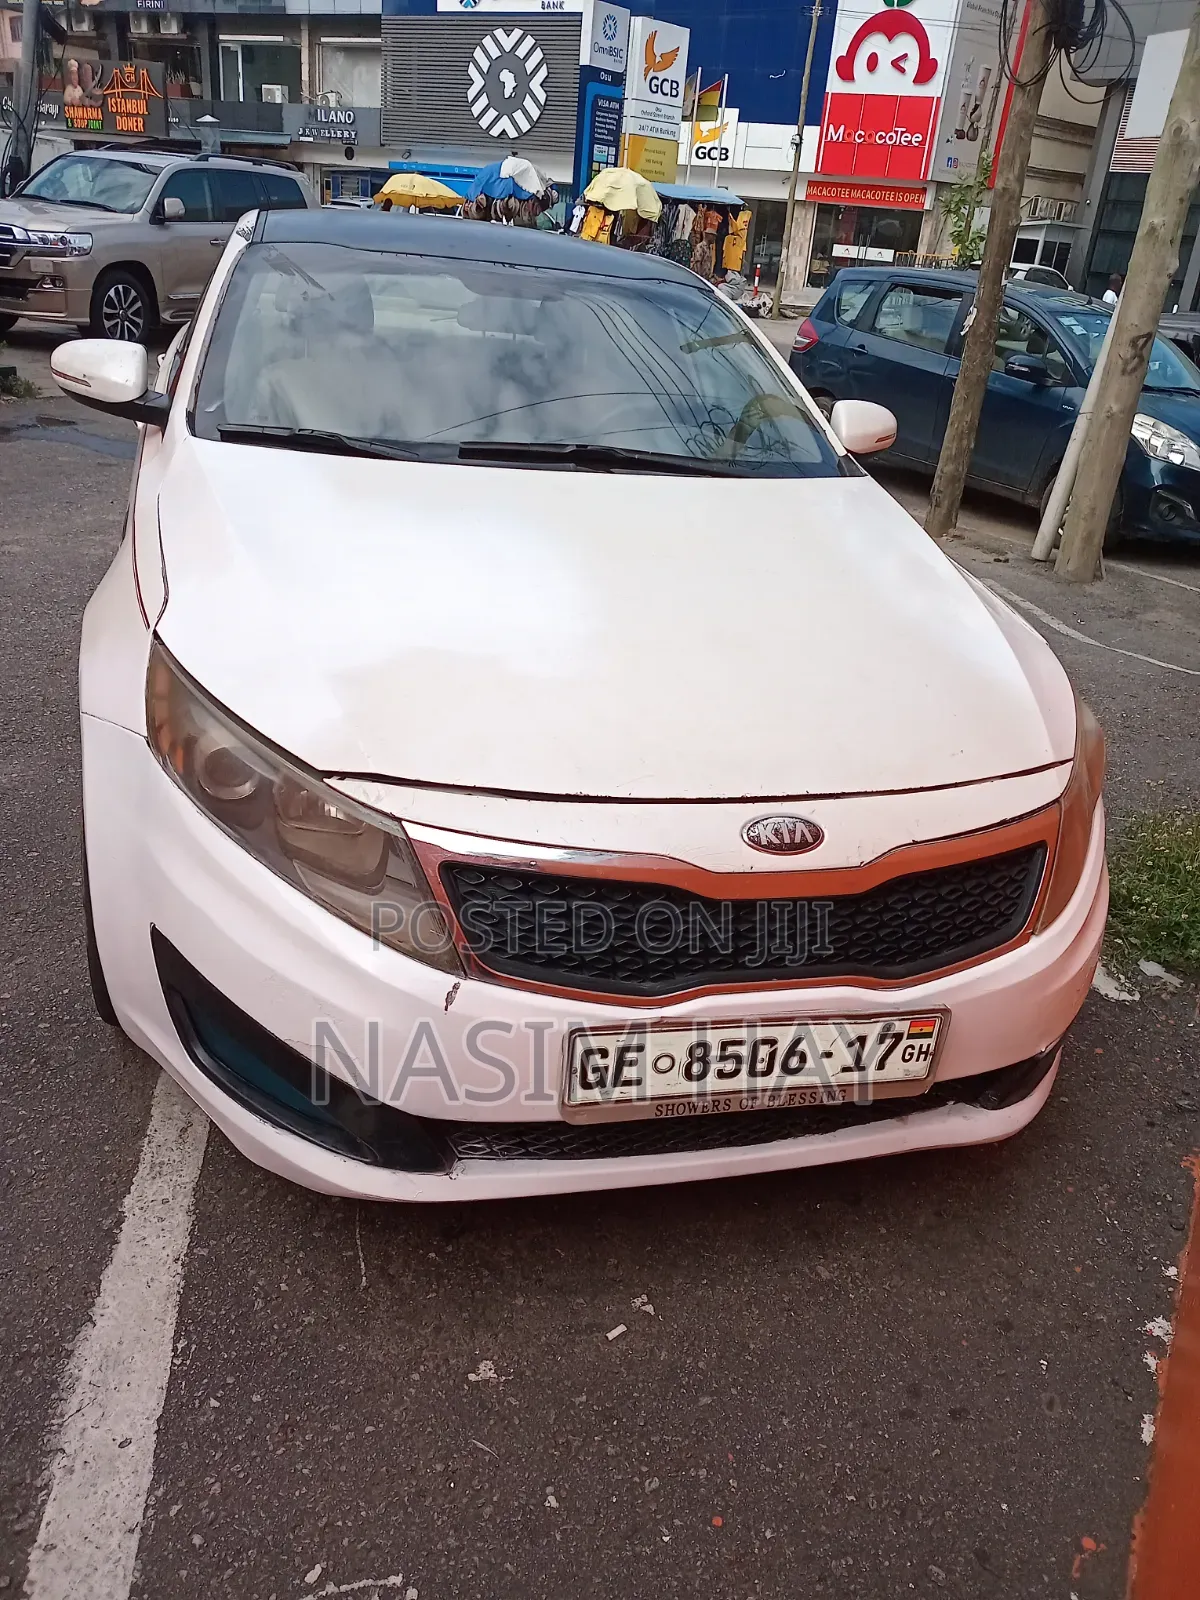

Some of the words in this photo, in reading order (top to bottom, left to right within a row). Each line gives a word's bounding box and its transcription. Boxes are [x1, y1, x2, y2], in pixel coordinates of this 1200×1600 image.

[541, 1, 565, 10] BANK
[600, 71, 612, 82] Osu
[648, 75, 680, 99] GCB
[64, 105, 103, 120] SHAWARMA
[108, 97, 149, 115] ISTANBUL
[73, 119, 88, 129] SOUP
[115, 113, 145, 132] DÖNER
[695, 145, 730, 161] GCB
[806, 185, 850, 199] MACACOTEE
[850, 187, 895, 201] MACACOTEE
[895, 191, 903, 202] IS
[757, 822, 814, 845] KIA
[900, 1042, 931, 1064] GH
[578, 1043, 647, 1091] GE
[654, 1099, 733, 1118] SHOWERS
[738, 1097, 758, 1111] OF
[766, 1089, 848, 1109] BLESSING
